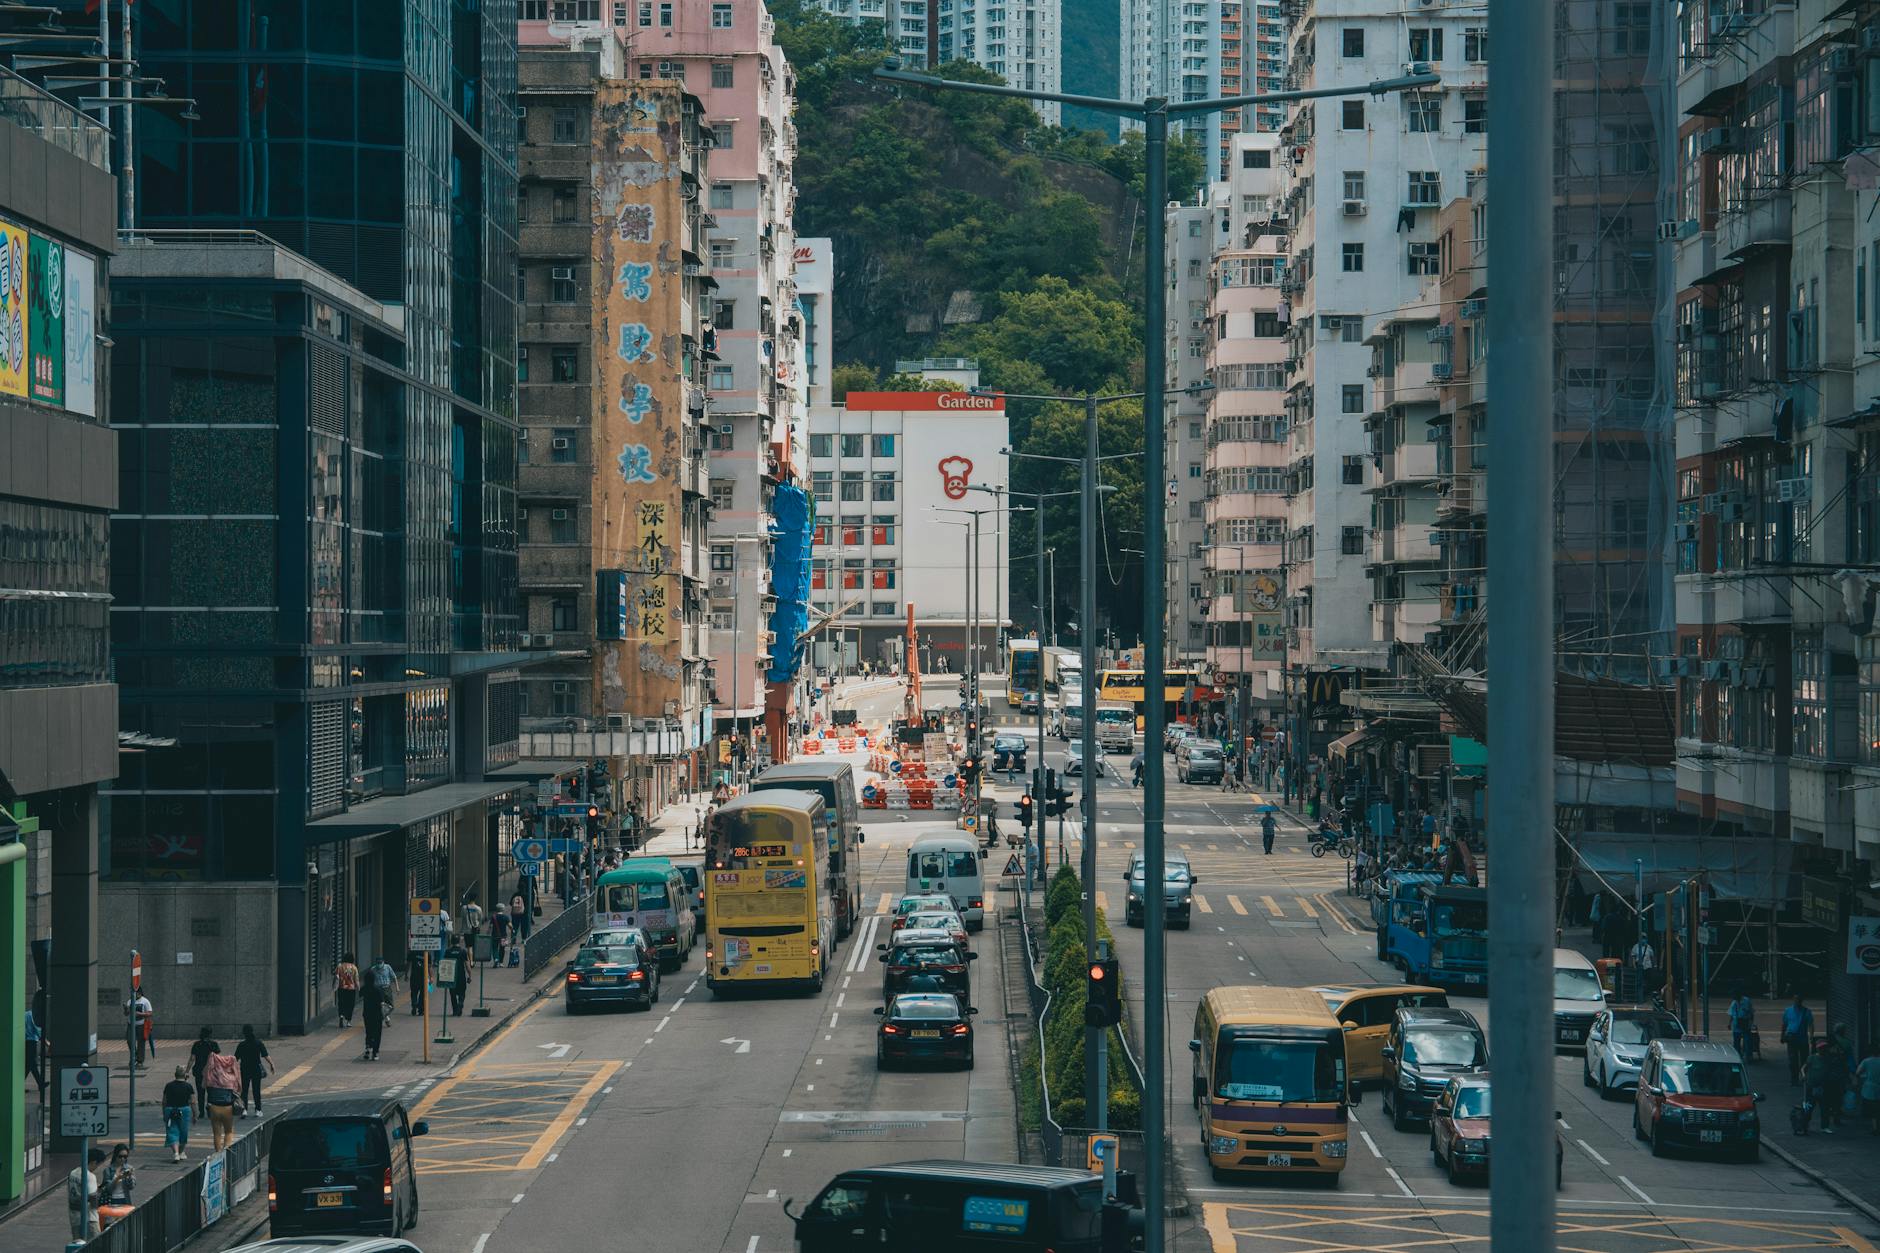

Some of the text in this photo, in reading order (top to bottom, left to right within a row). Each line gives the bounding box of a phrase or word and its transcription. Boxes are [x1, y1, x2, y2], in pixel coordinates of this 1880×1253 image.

[937, 393, 994, 409] Garden
[90, 1106, 98, 1117] 7
[91, 1122, 105, 1134] 12
